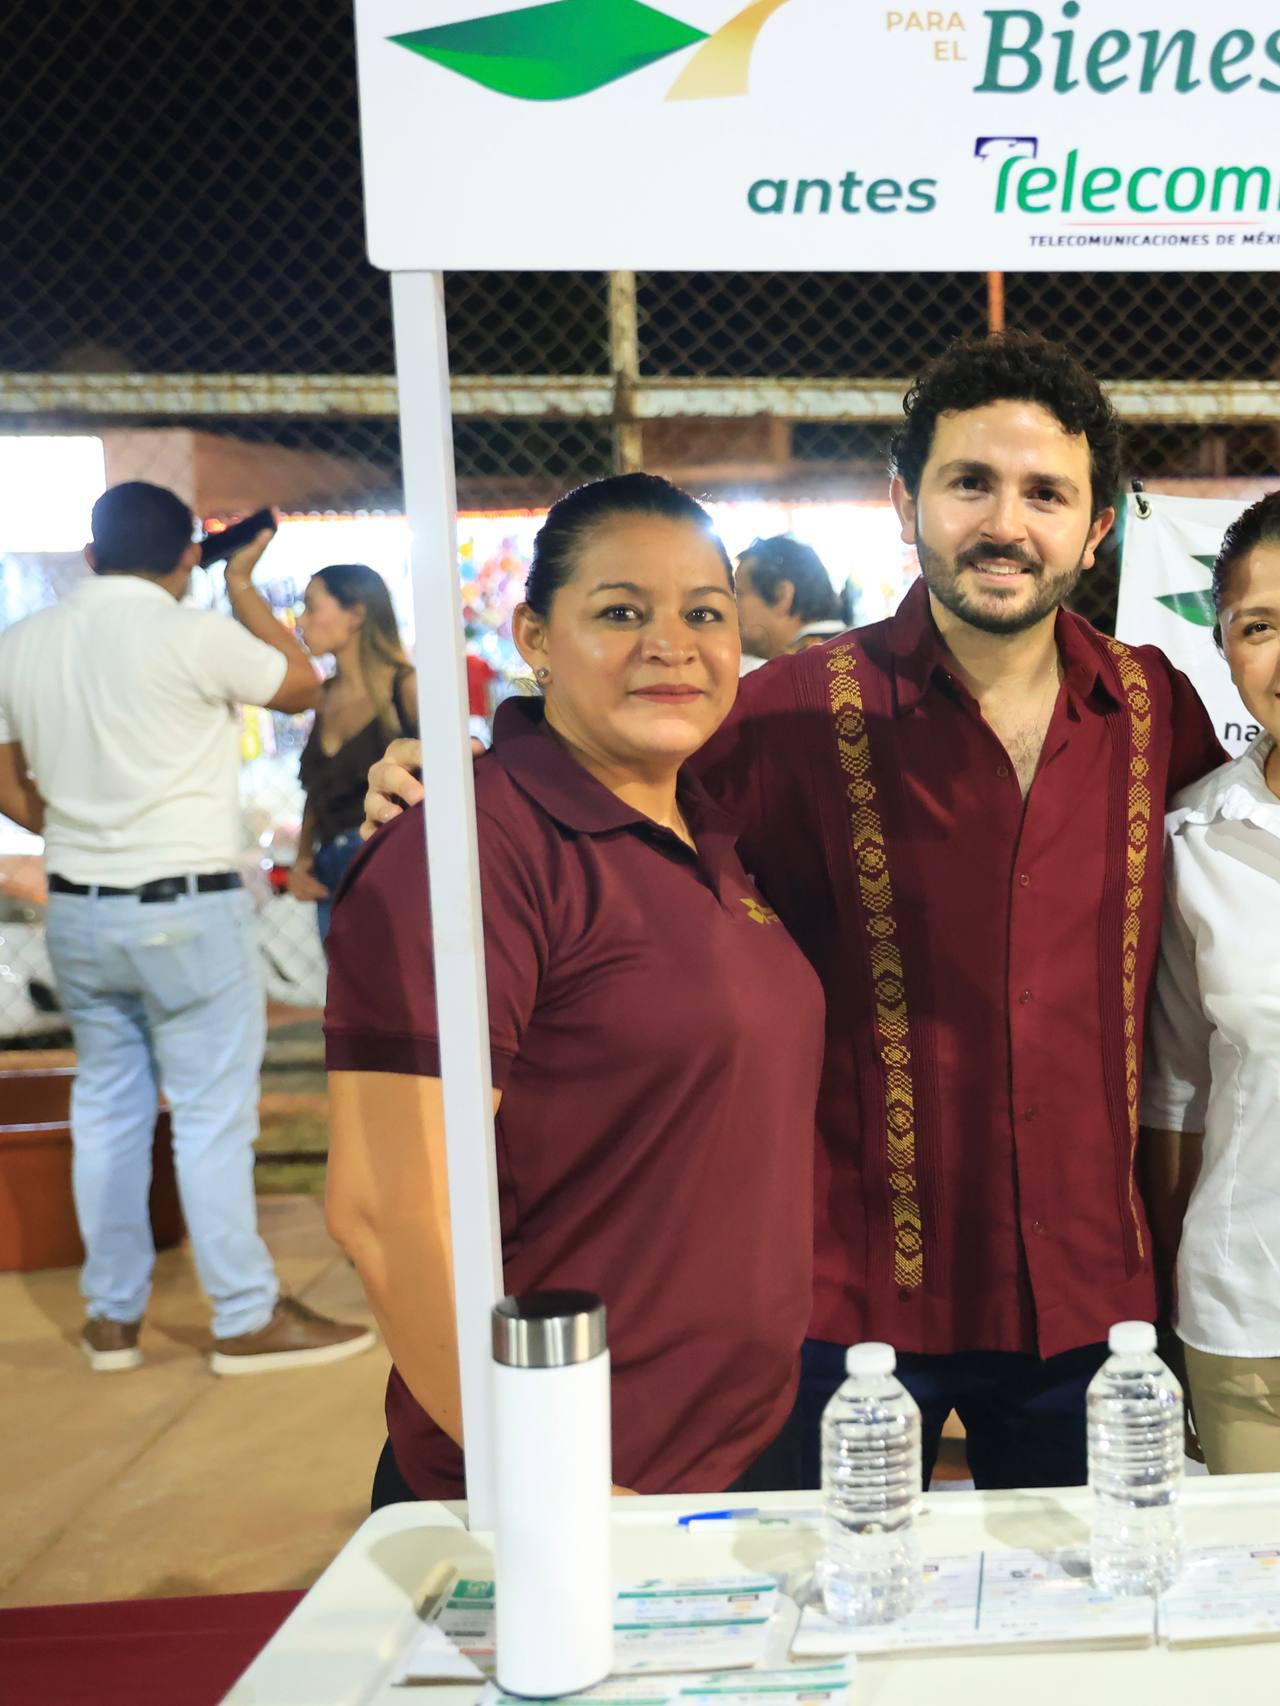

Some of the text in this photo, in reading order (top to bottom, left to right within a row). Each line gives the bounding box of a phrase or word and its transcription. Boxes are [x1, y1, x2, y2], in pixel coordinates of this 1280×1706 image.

[885, 11, 966, 32] PARA
[933, 40, 967, 61] EL
[747, 170, 938, 214] antes
[1029, 234, 1209, 247] TELECOMUNICACIONES
[1216, 234, 1236, 246] DE
